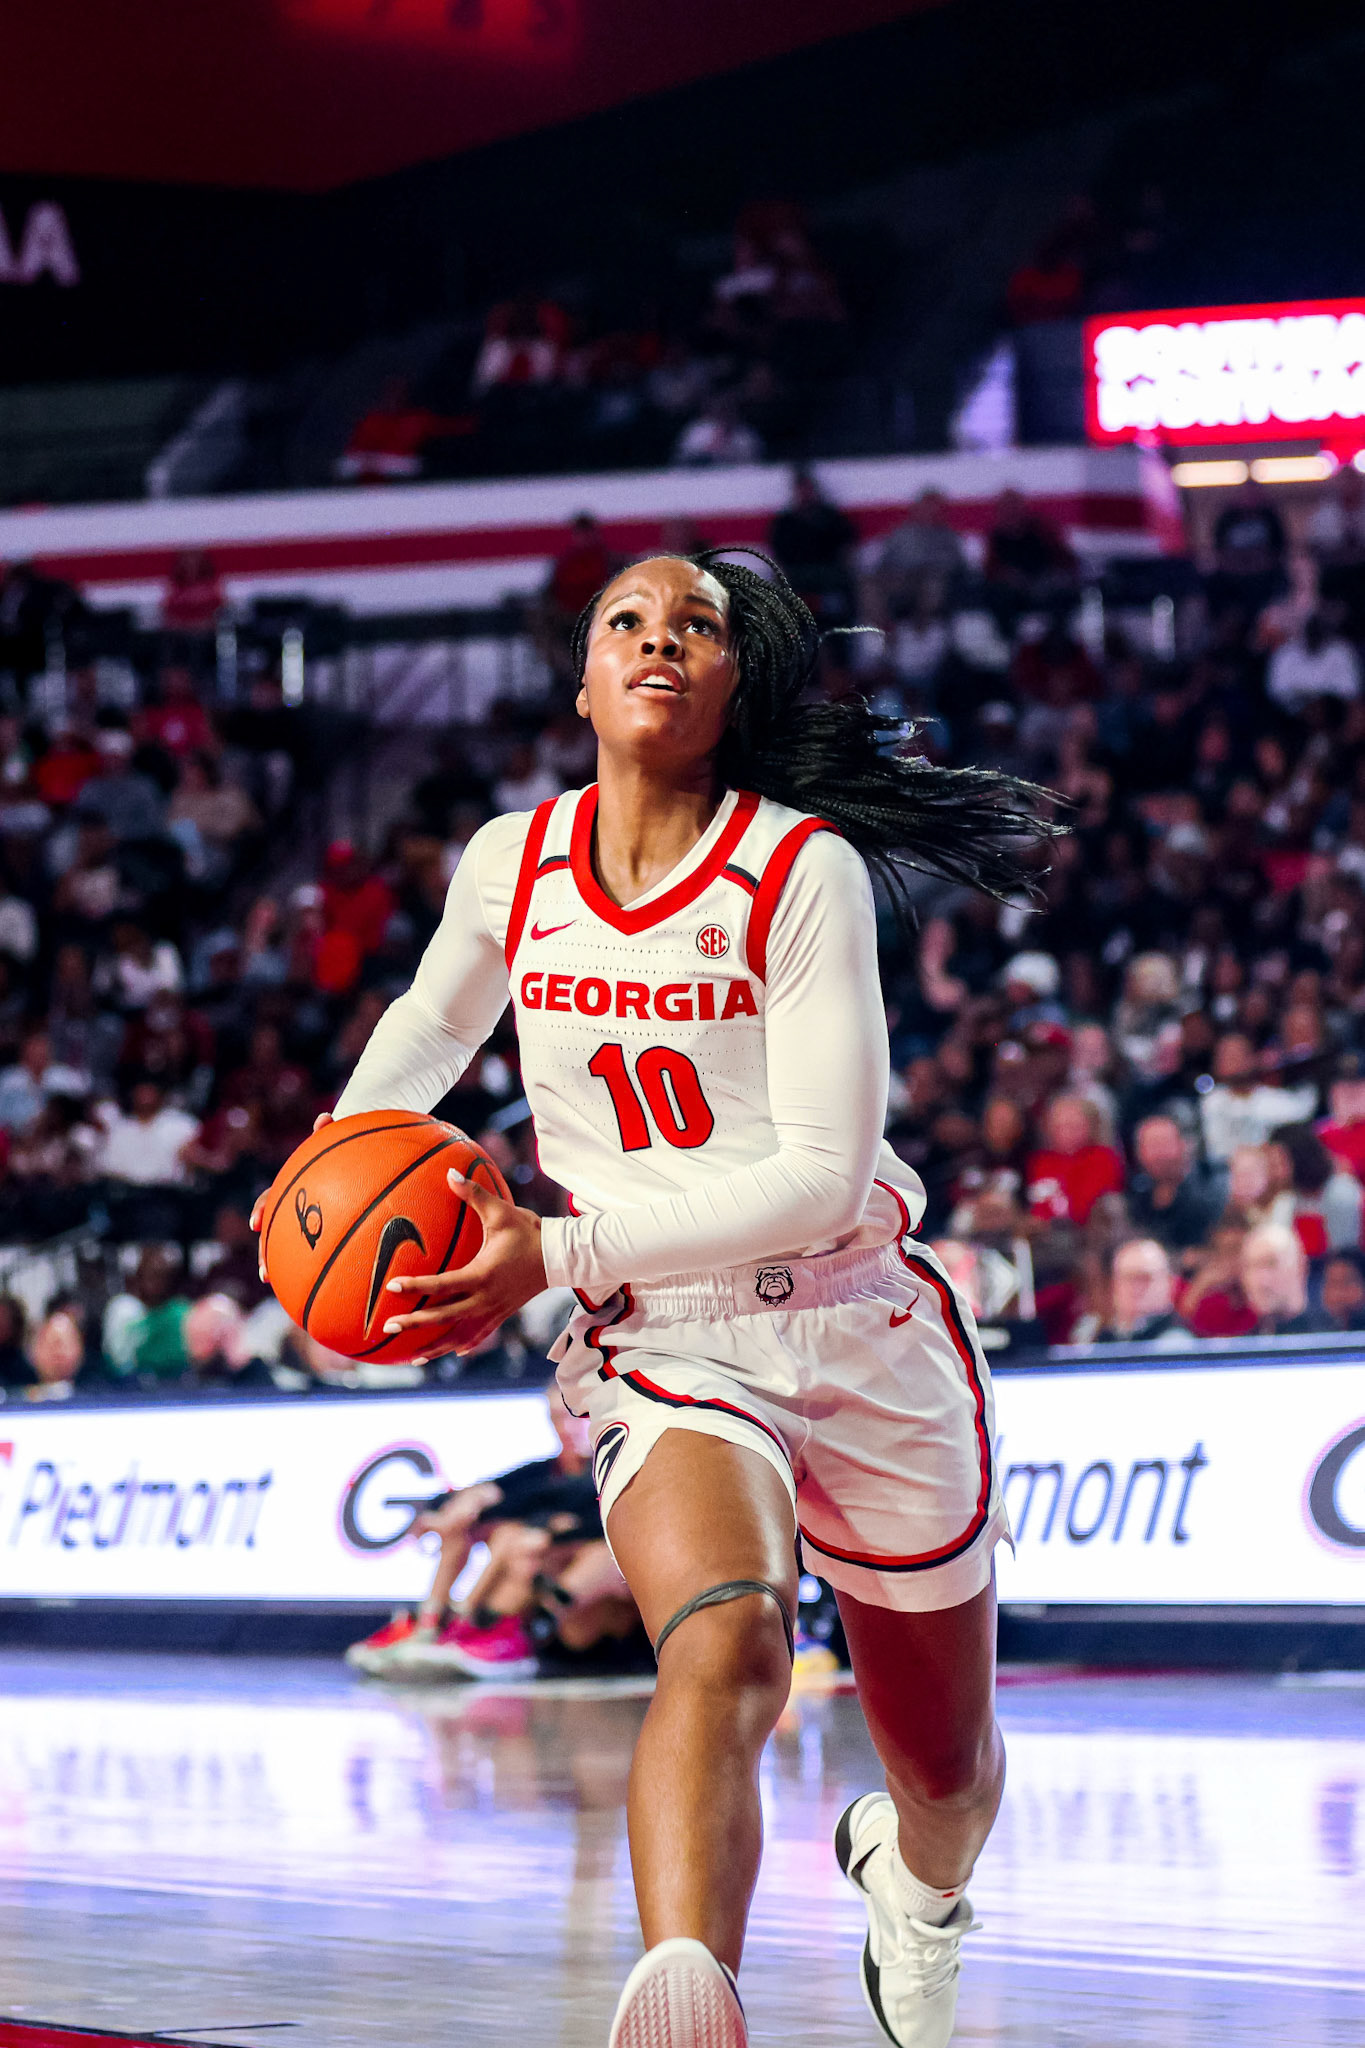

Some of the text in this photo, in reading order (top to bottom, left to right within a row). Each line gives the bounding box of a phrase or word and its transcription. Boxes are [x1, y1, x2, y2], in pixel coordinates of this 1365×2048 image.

[699, 926, 727, 956] SEC
[521, 972, 759, 1021] GEORGIA
[588, 1043, 715, 1152] 10
[9, 1459, 274, 1549] Piedmont
